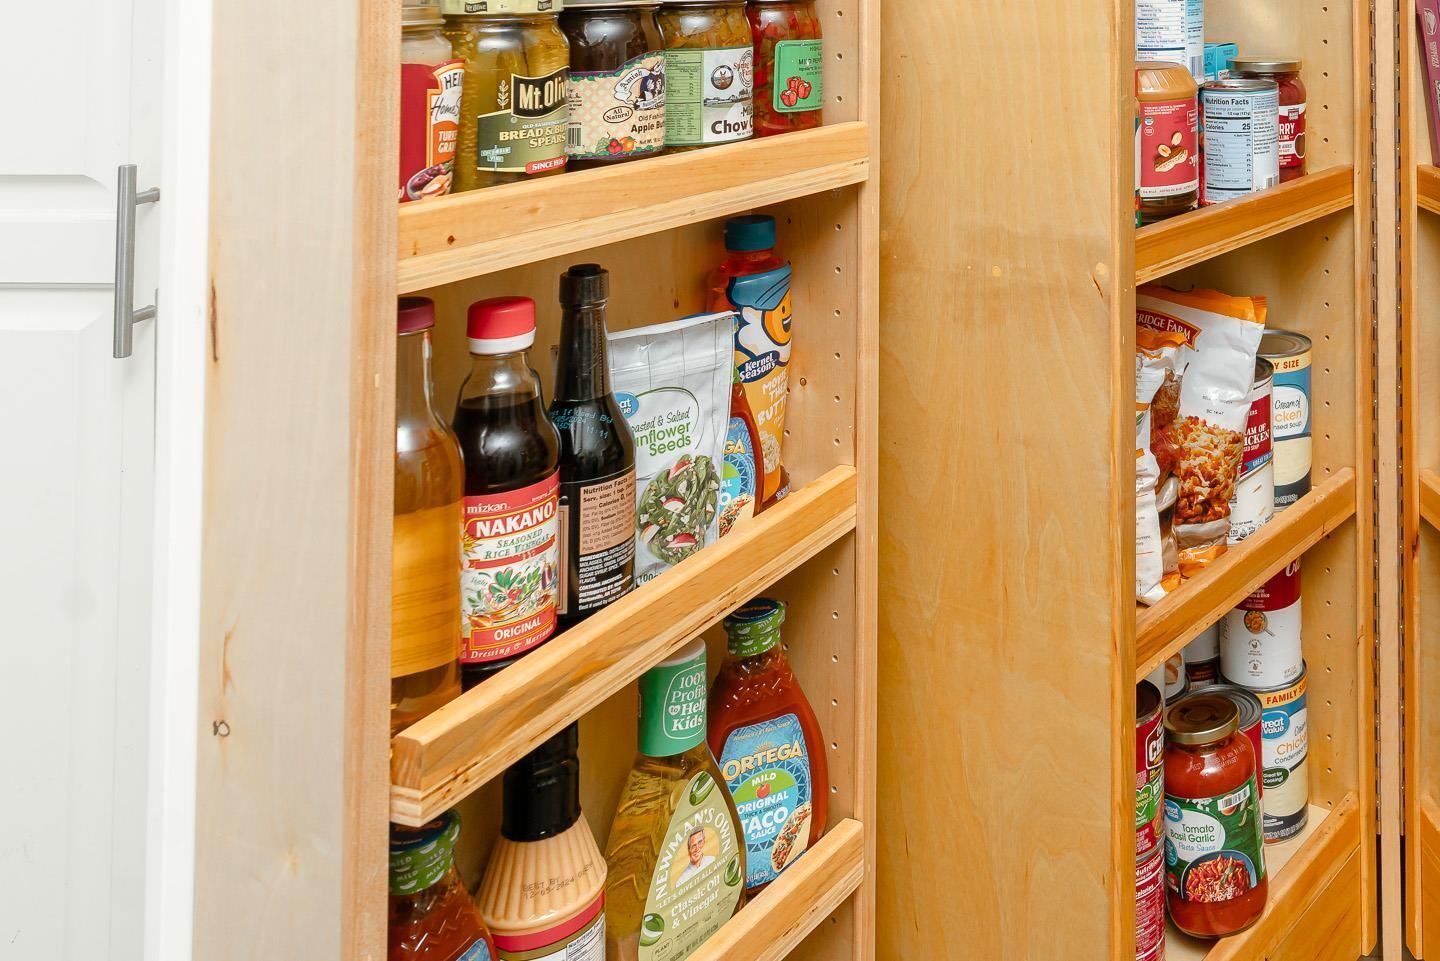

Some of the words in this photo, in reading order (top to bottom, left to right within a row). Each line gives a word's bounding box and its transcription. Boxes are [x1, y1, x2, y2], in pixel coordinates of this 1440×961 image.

[620, 69, 643, 91] Amish
[518, 83, 544, 111] Mt.
[1231, 98, 1250, 106] Facts
[606, 111, 630, 121] Natural
[499, 127, 544, 141] BREAD
[545, 127, 553, 138] &
[630, 122, 655, 134] Apple
[710, 119, 748, 135] Chow
[1242, 123, 1251, 131] 25
[529, 132, 566, 149] SPEARS
[531, 160, 548, 171] SINCE
[1166, 319, 1192, 340] FARM
[744, 352, 774, 372] Kernel
[1283, 359, 1300, 370] SIZE
[666, 406, 691, 424] Salted
[649, 434, 691, 457] Seeds
[582, 483, 613, 496] Nutrition
[613, 477, 629, 488] Facts
[582, 495, 598, 503] Serv.
[598, 498, 620, 509] Calories
[466, 501, 508, 515] mizkan
[475, 501, 555, 538] NAKANO
[484, 548, 511, 560] RICE
[514, 533, 550, 554] VINEGAR
[496, 528, 544, 549] SEASONED
[493, 617, 542, 641] ORIGINAL
[470, 646, 511, 660] Dressing
[1266, 689, 1299, 705] FAMILY
[671, 714, 703, 732] Kids
[722, 739, 804, 782] ORTEGA
[751, 771, 777, 788] MILD
[737, 789, 789, 814] ORIGINAL
[741, 807, 789, 837] TACO
[1181, 823, 1215, 833] Tomato
[751, 825, 777, 841] SAUCE
[1169, 828, 1188, 842] Basil
[1187, 833, 1216, 843] Garlic
[655, 807, 716, 902] NEWMAN'S
[714, 811, 733, 855] OWN
[671, 886, 706, 917] Classic
[706, 874, 721, 891] Oil
[671, 917, 682, 930] &
[682, 888, 721, 921] Vinegar
